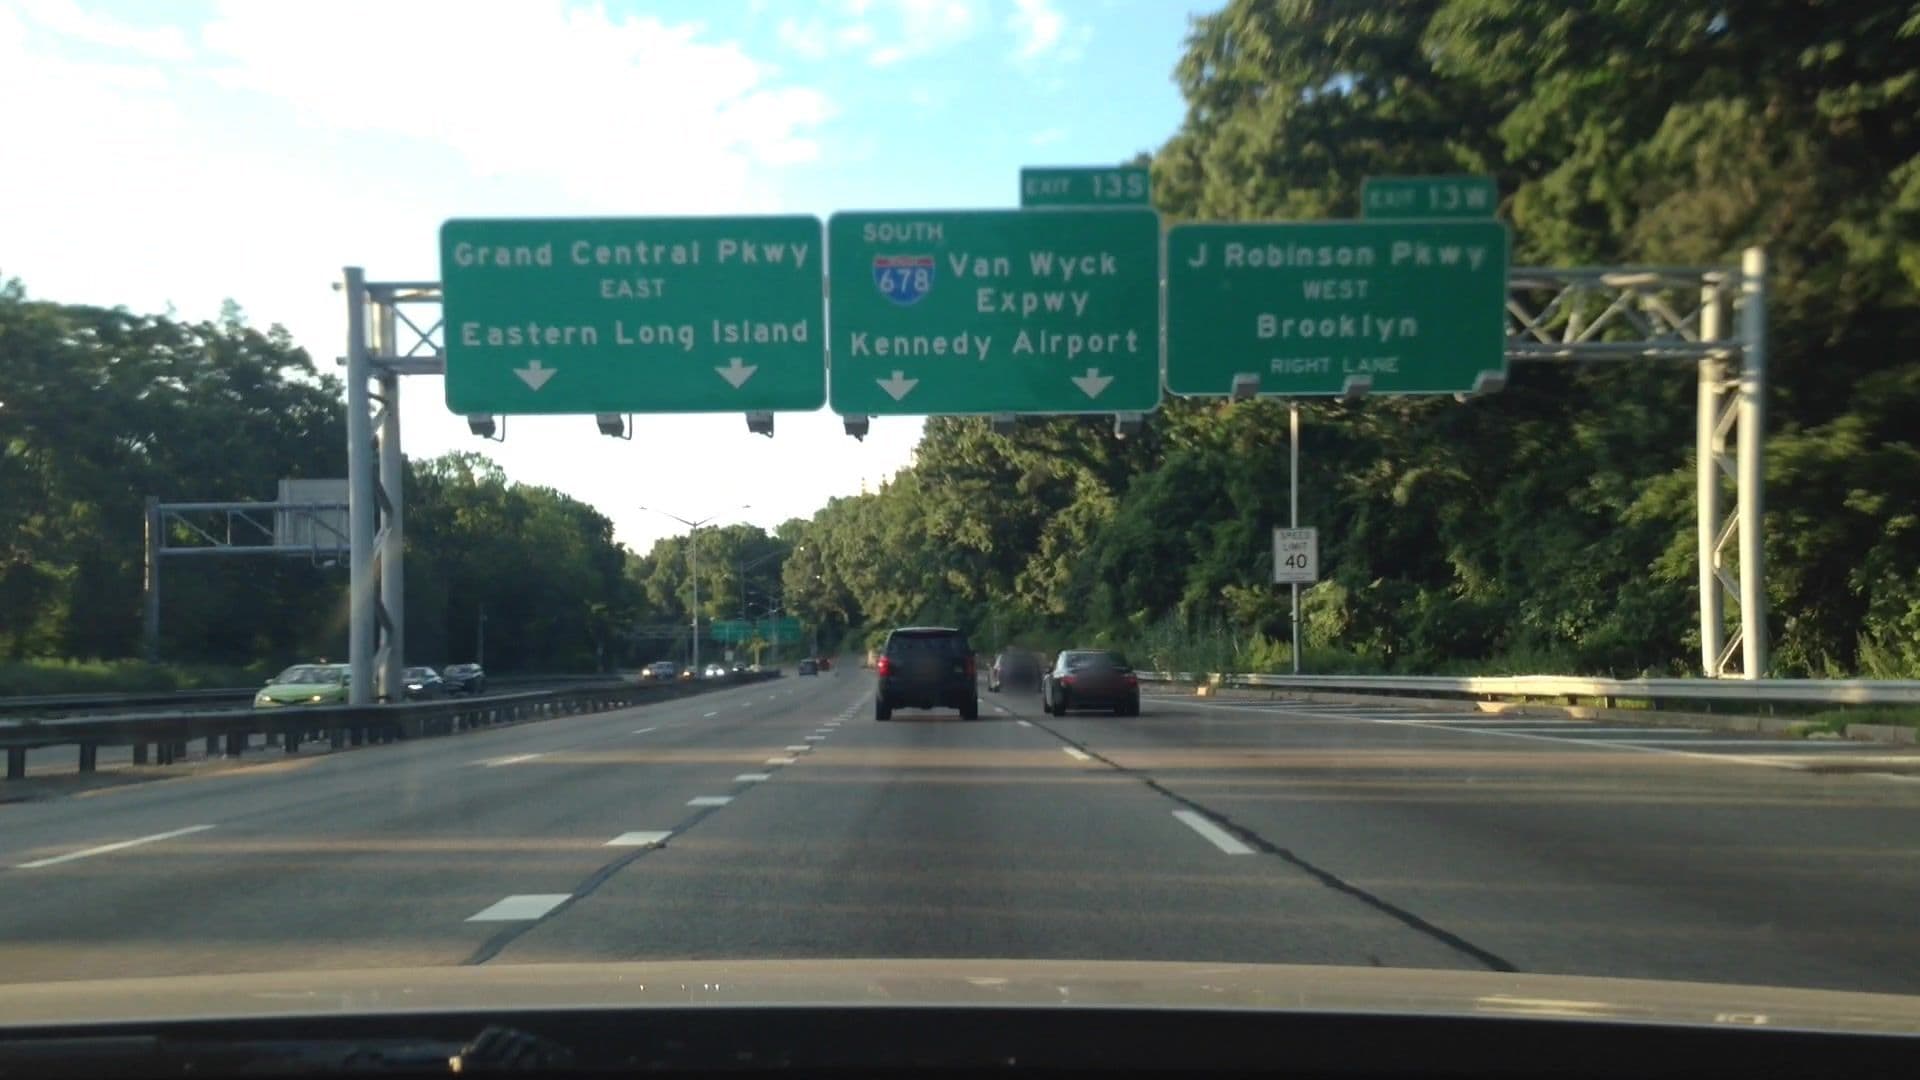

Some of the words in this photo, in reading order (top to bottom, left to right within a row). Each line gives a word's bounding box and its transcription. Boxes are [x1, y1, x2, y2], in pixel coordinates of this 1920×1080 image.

[1093, 175, 1145, 197] 13S
[1429, 186, 1489, 209] 13W
[863, 222, 944, 242] SOUTH
[454, 242, 553, 267] Grand
[571, 240, 699, 265] Central
[718, 239, 809, 269] Pkwy
[948, 251, 1009, 277] Van
[1029, 251, 1117, 281] Wyck
[1188, 243, 1208, 268] J
[1225, 243, 1375, 268] Robinson
[1391, 242, 1487, 271] Pkwy
[600, 279, 666, 299] EAST
[878, 269, 930, 295] 678
[1302, 280, 1369, 300] WEST
[976, 288, 1090, 317] Expwy
[462, 322, 597, 346] Eastern
[616, 320, 695, 351] Long
[713, 319, 808, 344] Island
[1256, 314, 1419, 342] Brooklyn
[850, 332, 992, 361] Kennedy
[1012, 330, 1138, 359] Airport
[1271, 357, 1331, 374] RIGHT
[1343, 357, 1399, 374] LANE
[1285, 554, 1308, 569] 40
